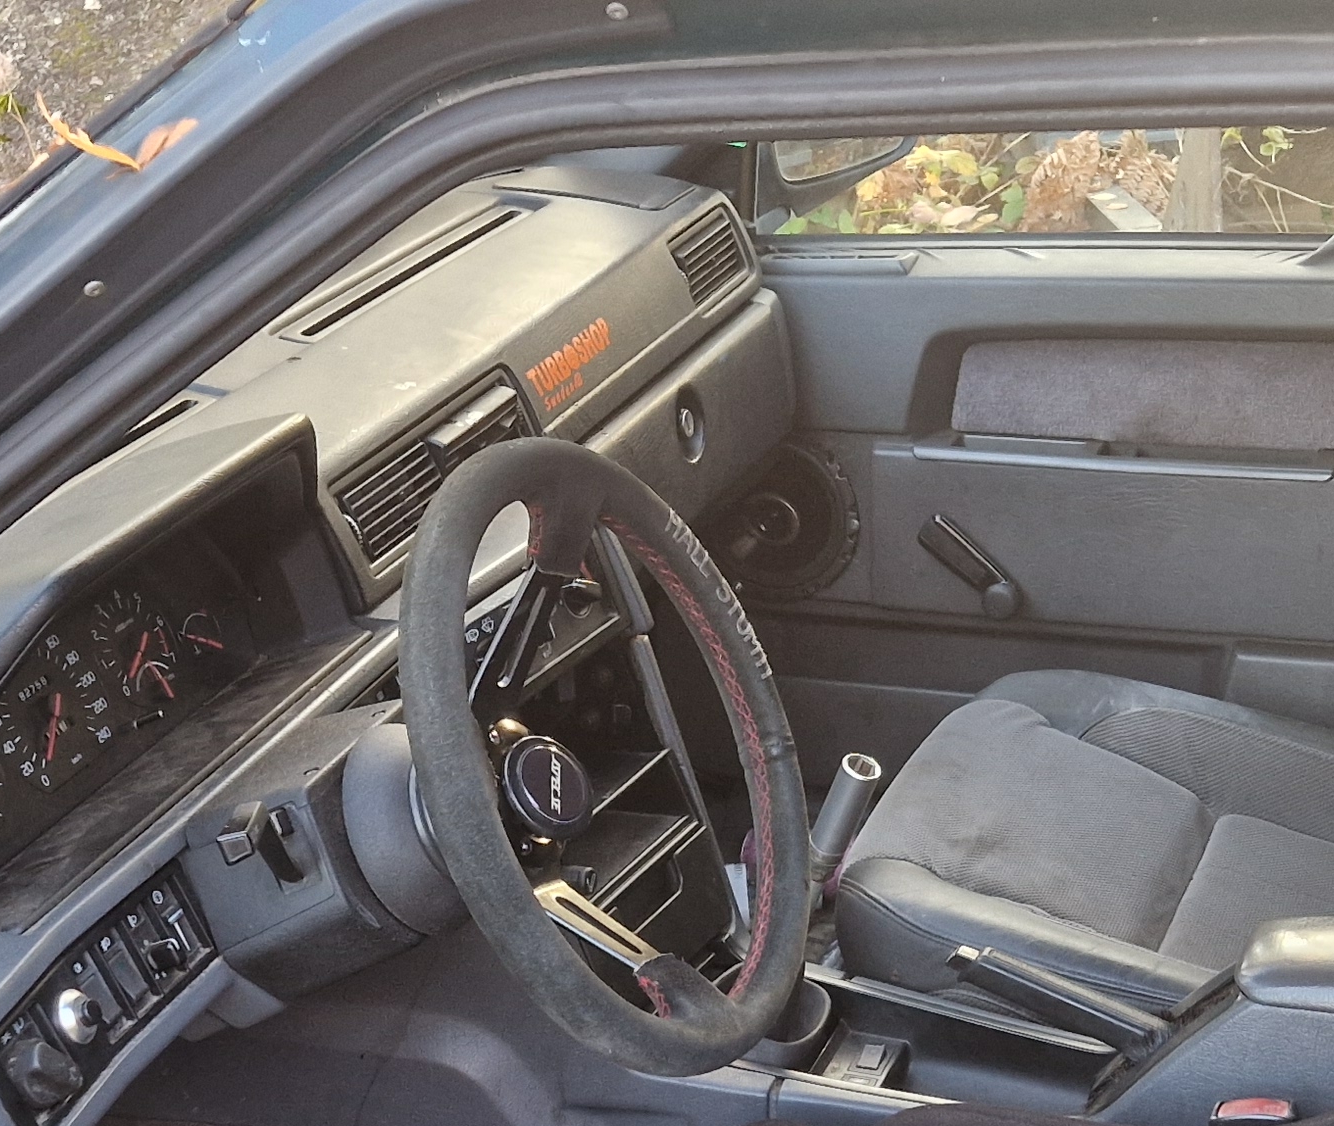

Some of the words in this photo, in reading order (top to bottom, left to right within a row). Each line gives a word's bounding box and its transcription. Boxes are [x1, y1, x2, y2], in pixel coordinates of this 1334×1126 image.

[525, 317, 611, 397] TURBOSHOP
[156, 615, 164, 627] 6
[91, 630, 100, 640] 2
[79, 671, 96, 688] 200
[122, 685, 131, 696] 0
[91, 697, 108, 714] 220
[95, 726, 112, 744] 240
[2, 739, 16, 755] 40
[20, 760, 35, 777] 20
[40, 774, 51, 787] 0
